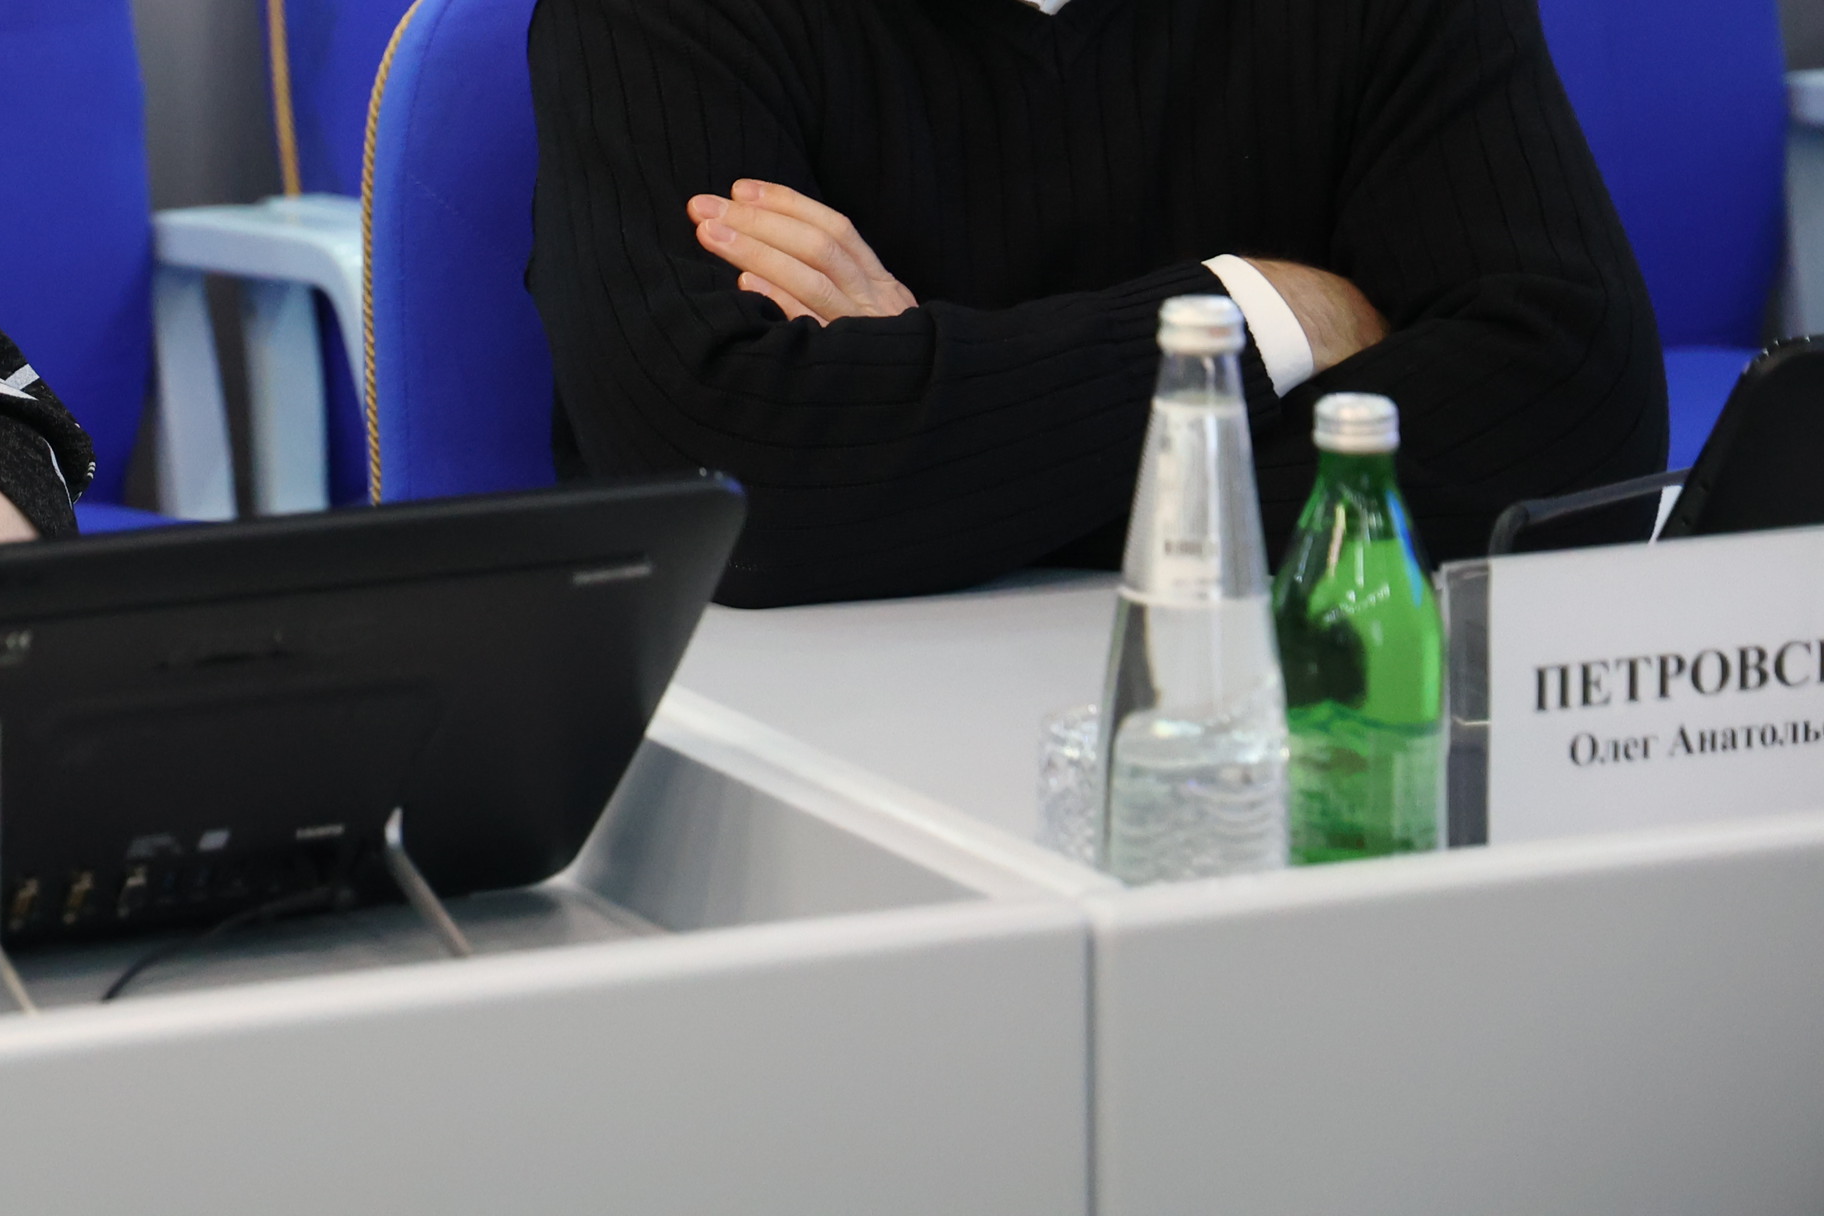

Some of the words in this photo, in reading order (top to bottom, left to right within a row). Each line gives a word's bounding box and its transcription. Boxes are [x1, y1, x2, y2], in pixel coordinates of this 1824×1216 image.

[1533, 637, 1824, 713] ПЕТРОВС
[1568, 732, 1658, 768] Олег
[1667, 718, 1824, 758] Анатоль
